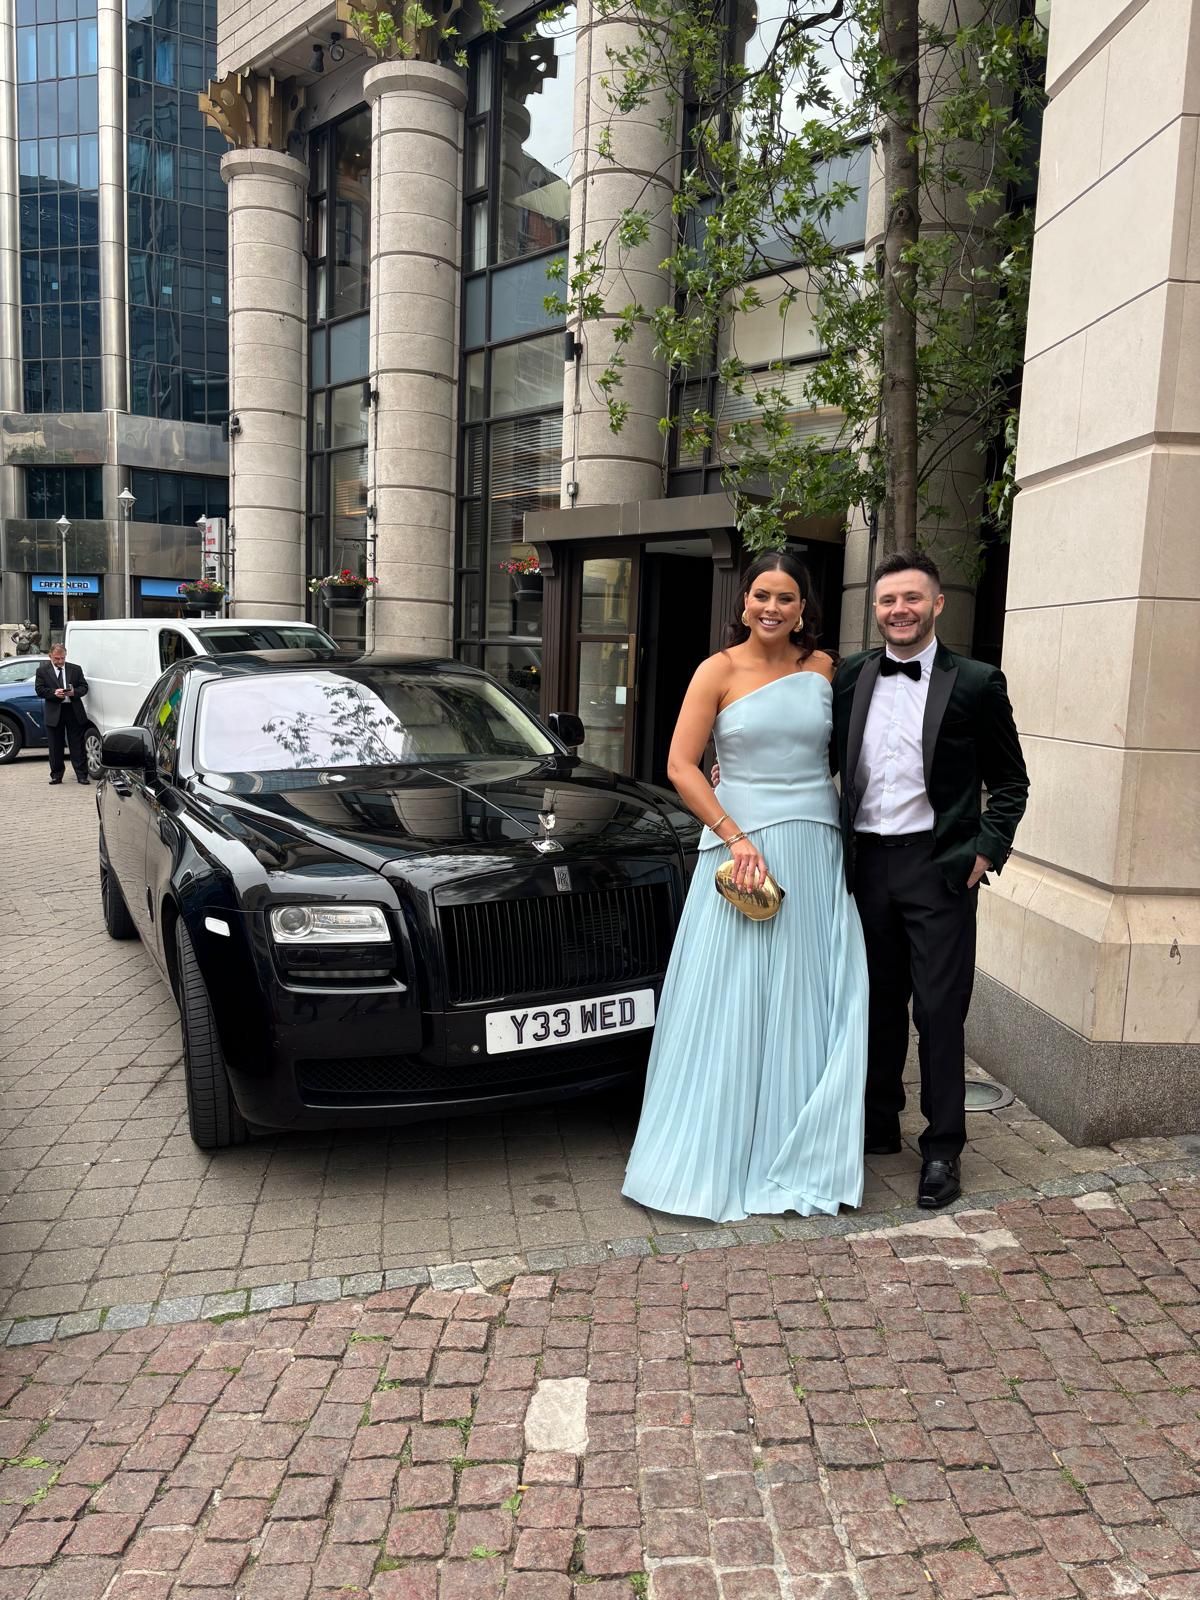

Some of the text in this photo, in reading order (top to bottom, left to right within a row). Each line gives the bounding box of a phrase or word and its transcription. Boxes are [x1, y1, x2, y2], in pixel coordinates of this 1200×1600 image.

[66, 581, 89, 589] NERO
[511, 997, 636, 1045] Y33 WED
